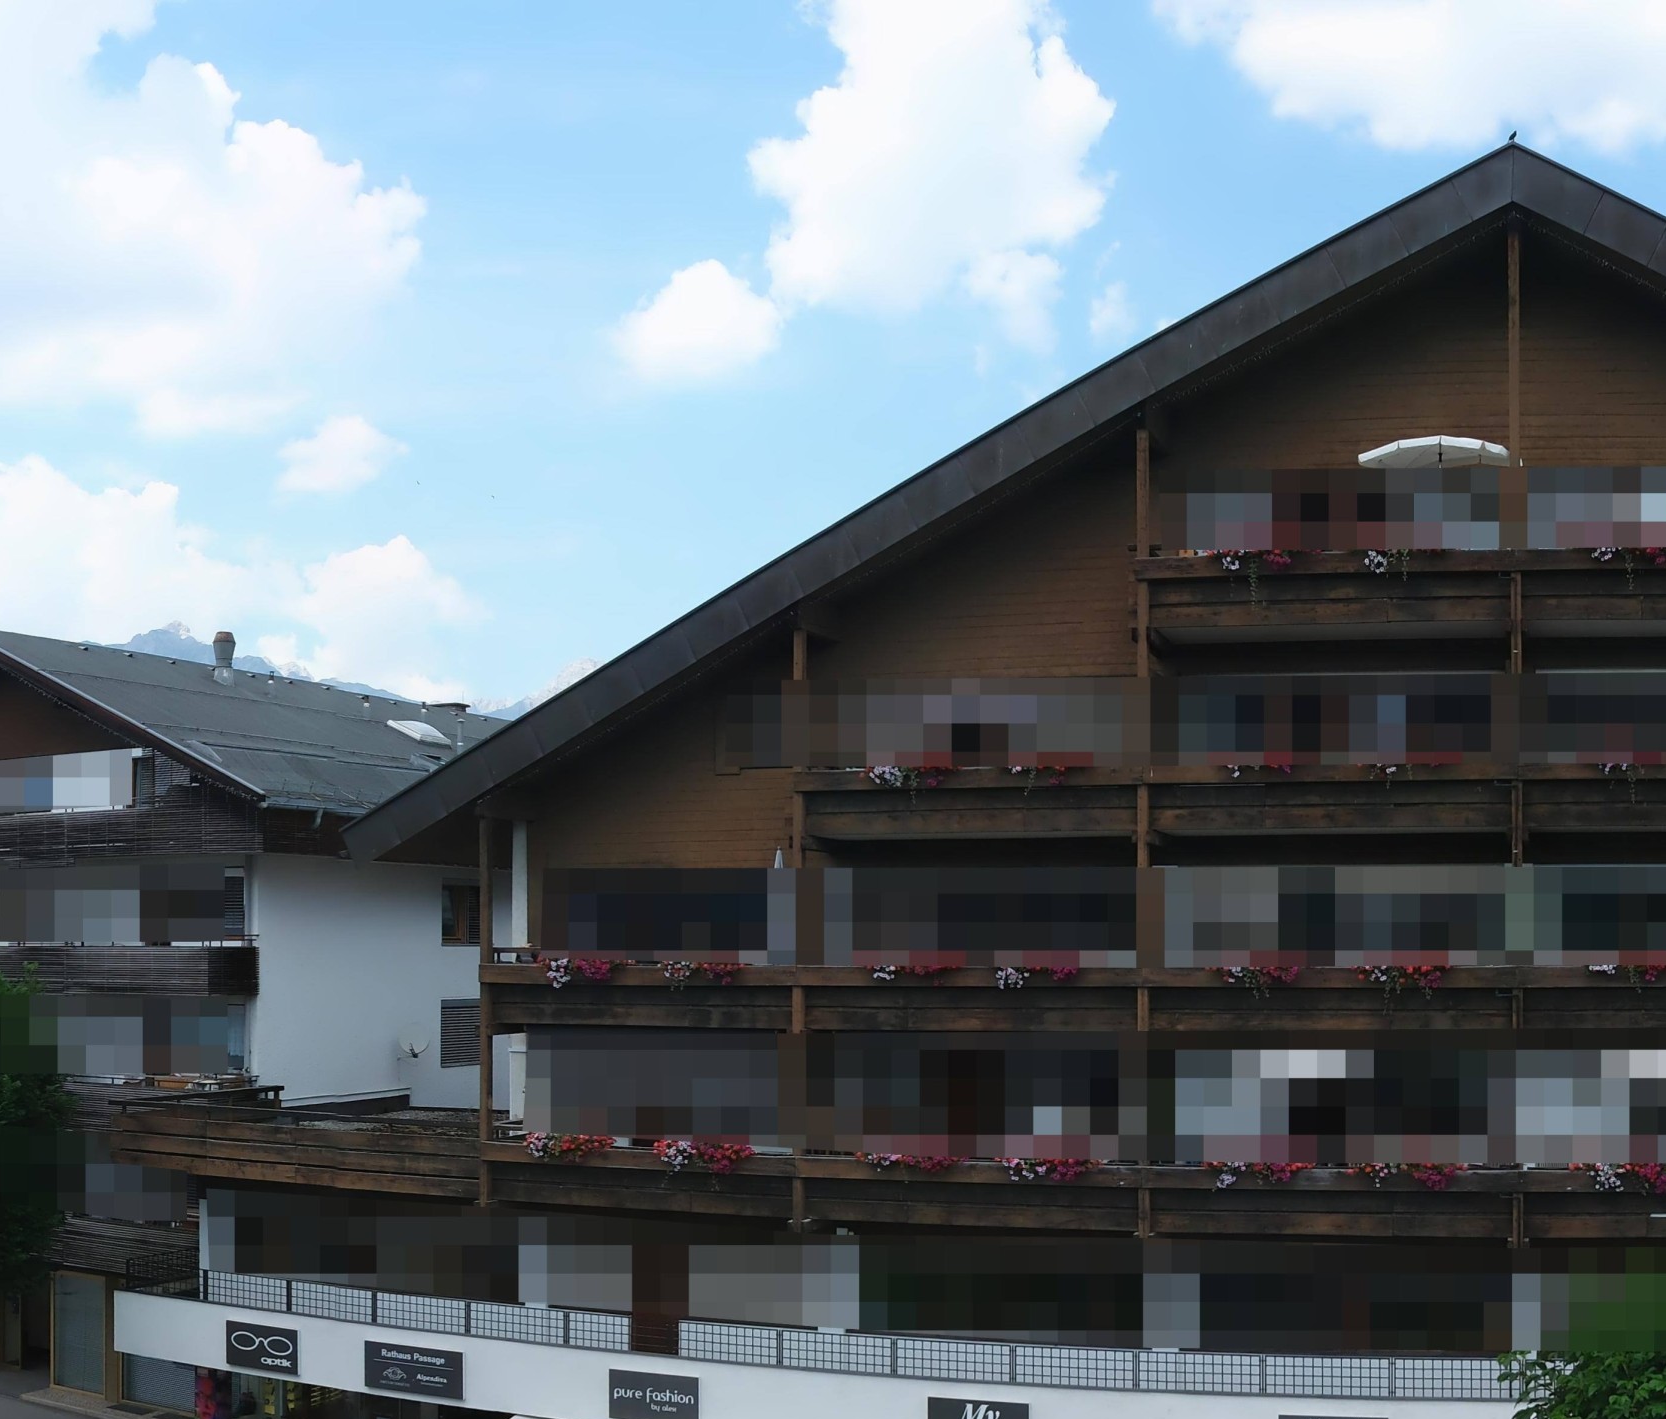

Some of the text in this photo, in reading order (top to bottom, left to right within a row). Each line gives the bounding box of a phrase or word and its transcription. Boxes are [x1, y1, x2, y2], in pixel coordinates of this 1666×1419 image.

[260, 1356, 292, 1368] optik
[381, 1348, 445, 1365] Rathaus Passage
[614, 1387, 694, 1405] pure fashion
[651, 1403, 660, 1412] by
